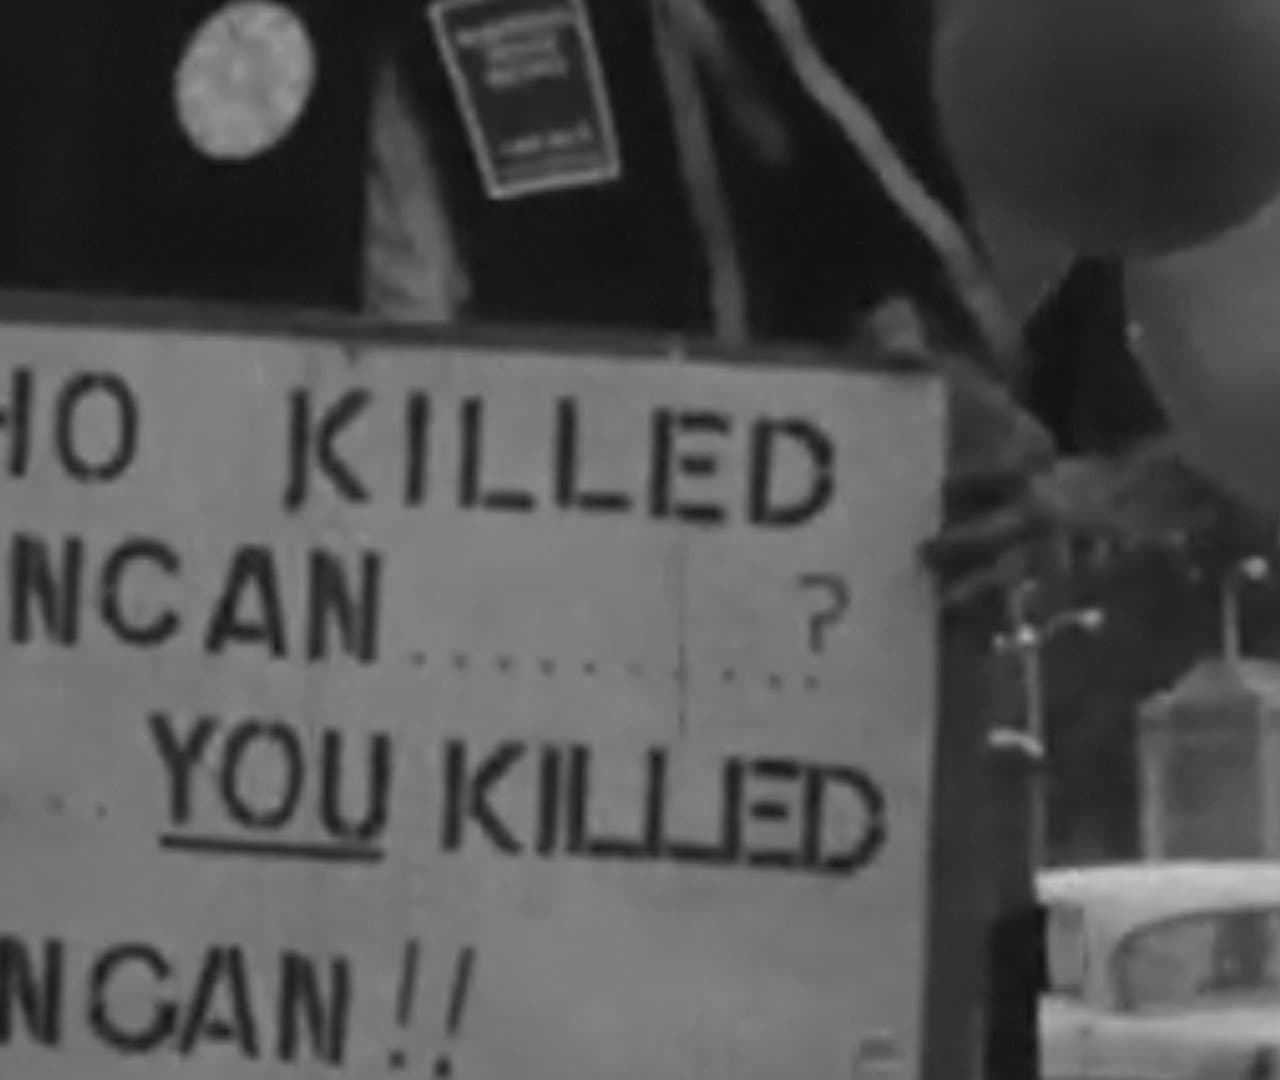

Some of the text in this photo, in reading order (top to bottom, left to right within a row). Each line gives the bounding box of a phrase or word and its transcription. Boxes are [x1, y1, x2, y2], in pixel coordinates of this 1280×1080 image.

[283, 387, 836, 526] KILLED
[149, 713, 391, 844] YOU
[442, 740, 887, 875] KILLED
